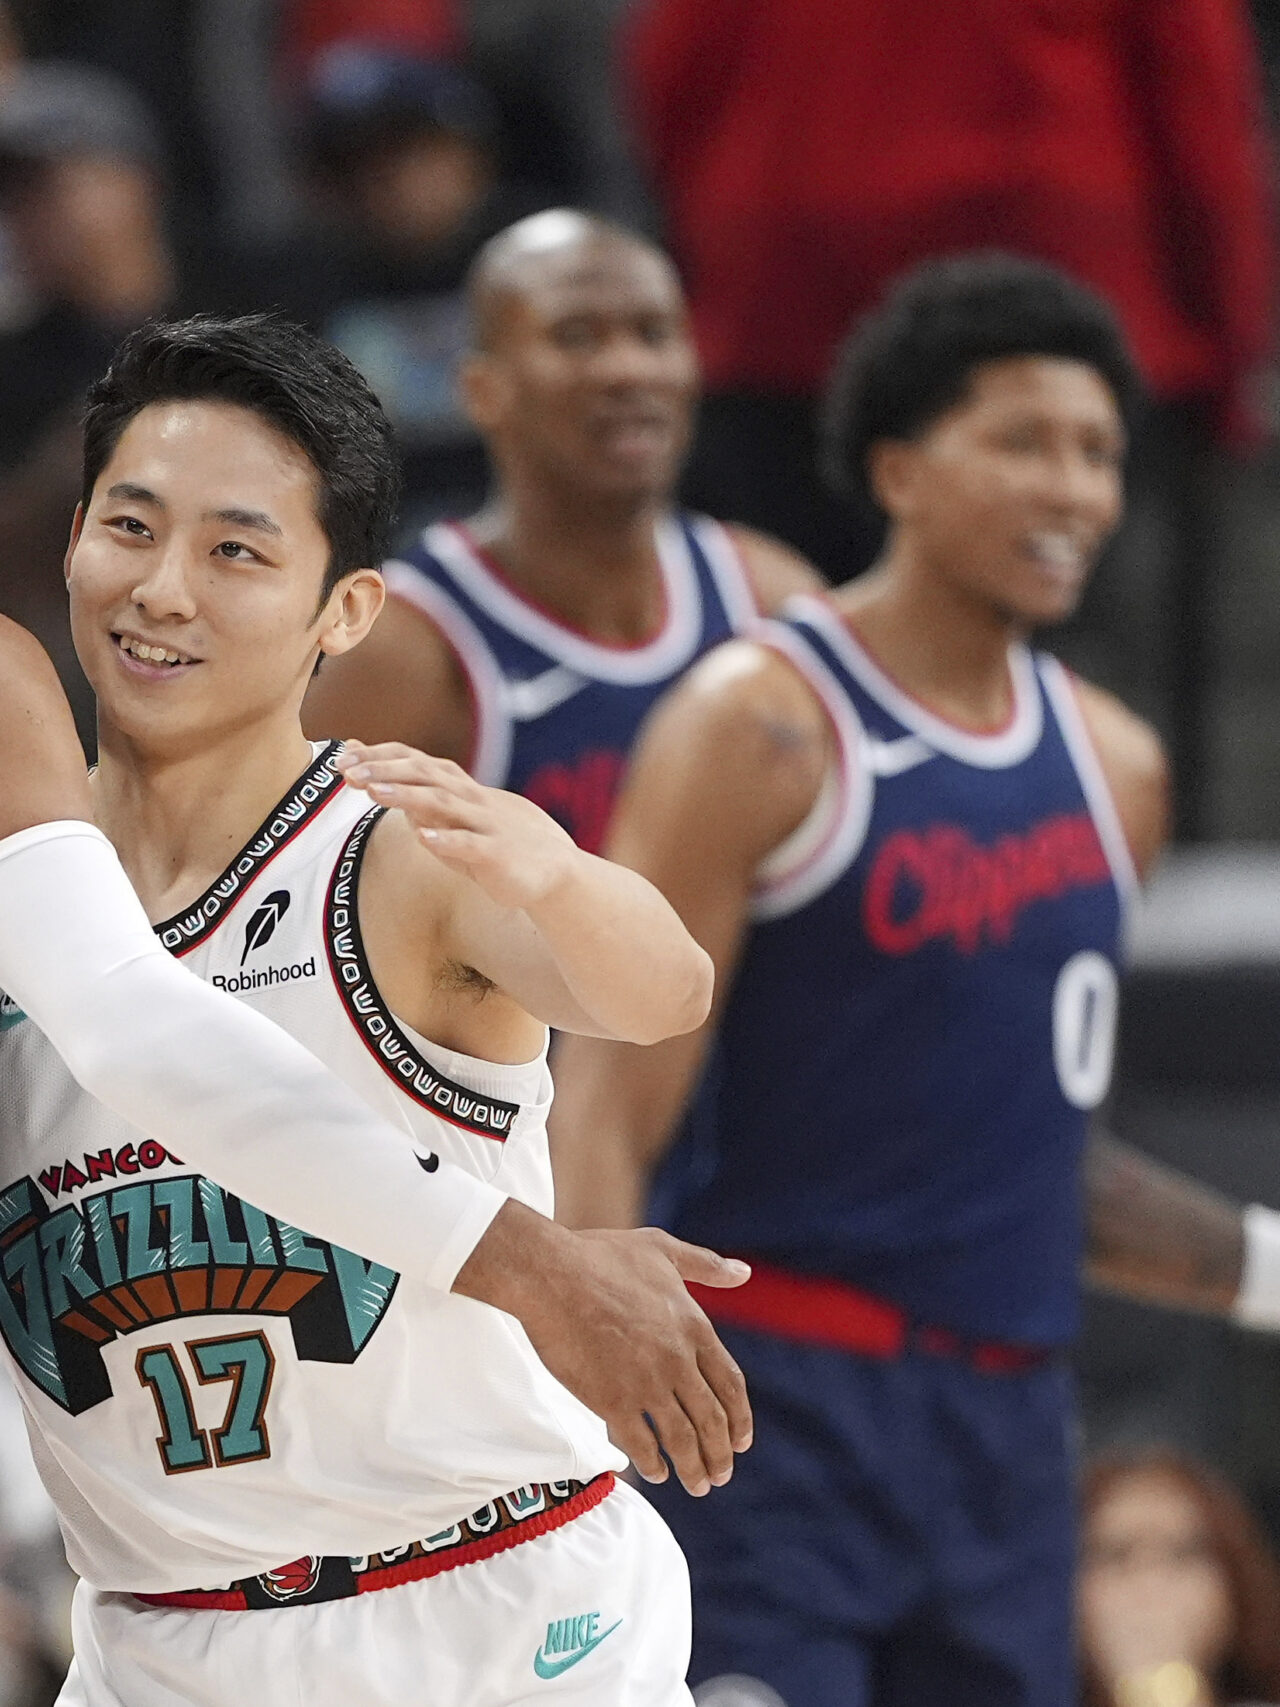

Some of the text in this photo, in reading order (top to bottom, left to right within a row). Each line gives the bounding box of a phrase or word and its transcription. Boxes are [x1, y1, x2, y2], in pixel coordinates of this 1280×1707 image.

[213, 957, 316, 993] Robinhood
[1052, 949, 1119, 1110] 0
[37, 1138, 185, 1199] VANCO
[135, 1329, 276, 1475] 17
[543, 1611, 602, 1656] NIKE
